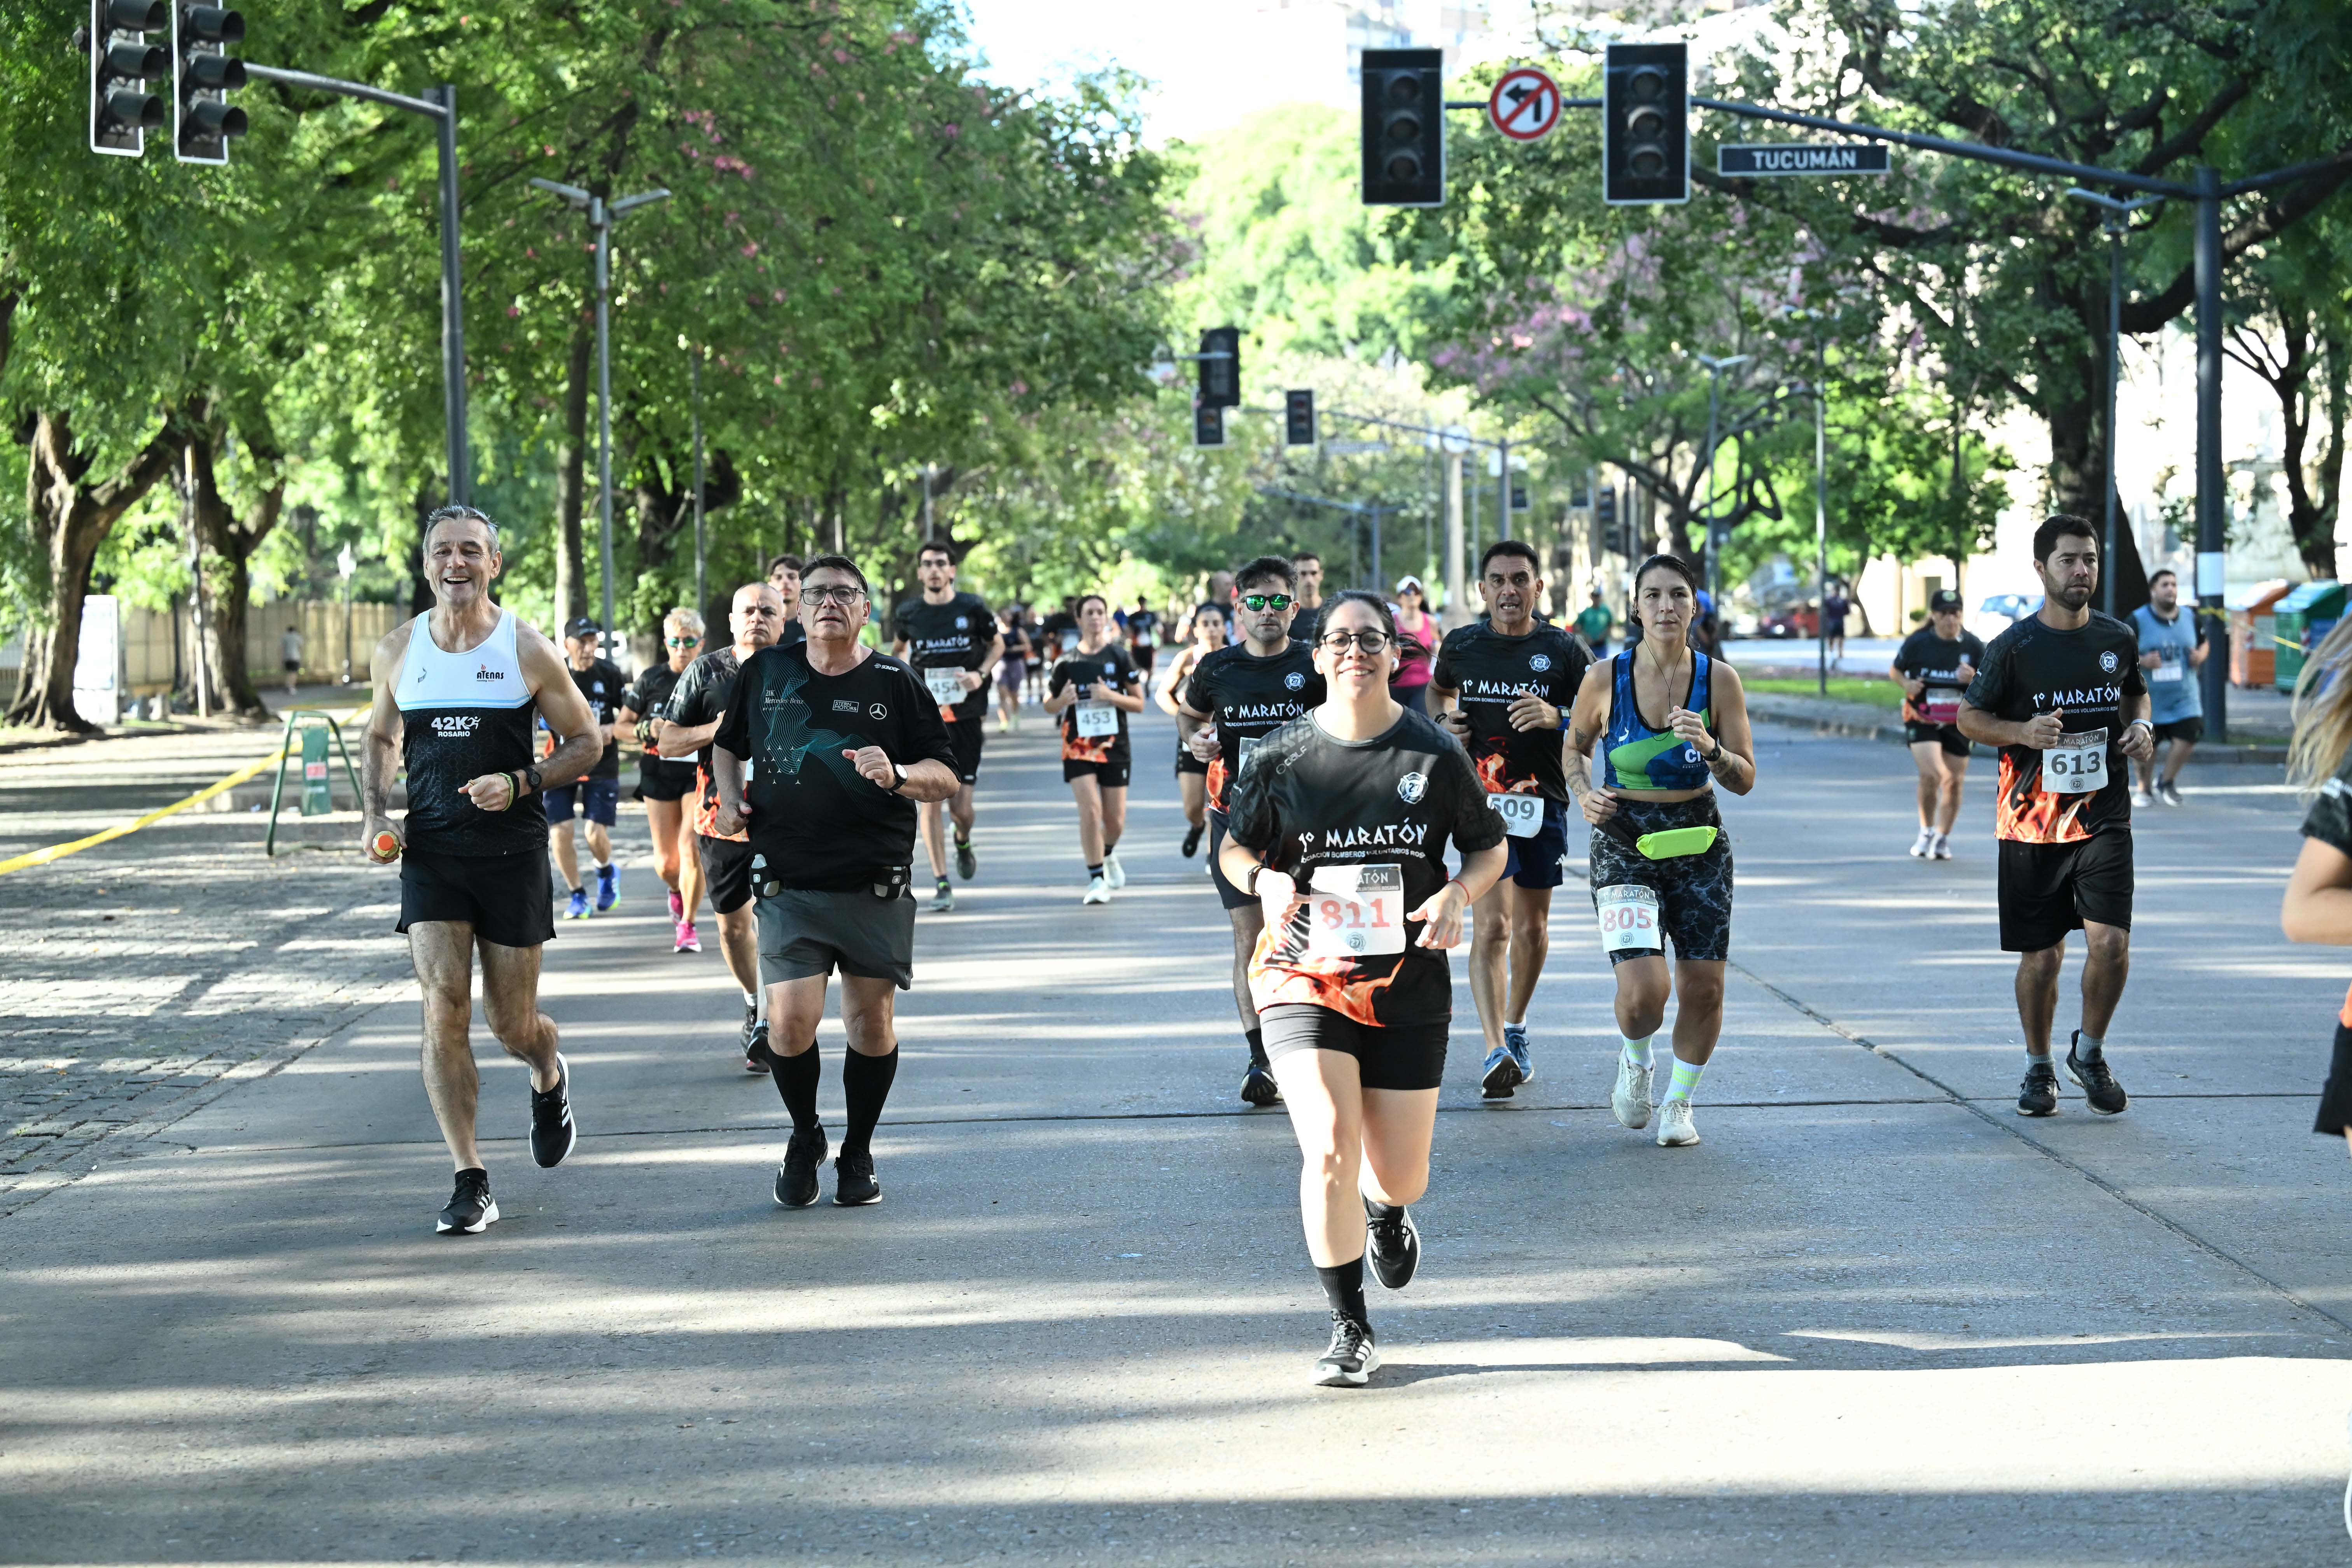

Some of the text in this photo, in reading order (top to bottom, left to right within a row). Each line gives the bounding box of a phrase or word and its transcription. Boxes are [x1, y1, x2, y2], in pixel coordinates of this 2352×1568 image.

[1751, 145, 1857, 170] TUCUMÁN
[477, 670, 504, 679] ATENAS
[931, 681, 960, 693] 454
[1478, 679, 1549, 698] MARATÓN
[2052, 682, 2120, 706] MARATÓN
[1082, 711, 1111, 725] 453
[1239, 699, 1304, 719] MARATÓN
[431, 716, 470, 730] 42K
[2063, 733, 2099, 746] MARATÓN
[2051, 751, 2100, 775] 613
[1325, 817, 1428, 848] MARATÓN
[1611, 888, 1649, 899] MARATÓN
[1321, 898, 1390, 930] 811
[1603, 907, 1652, 932] 805
